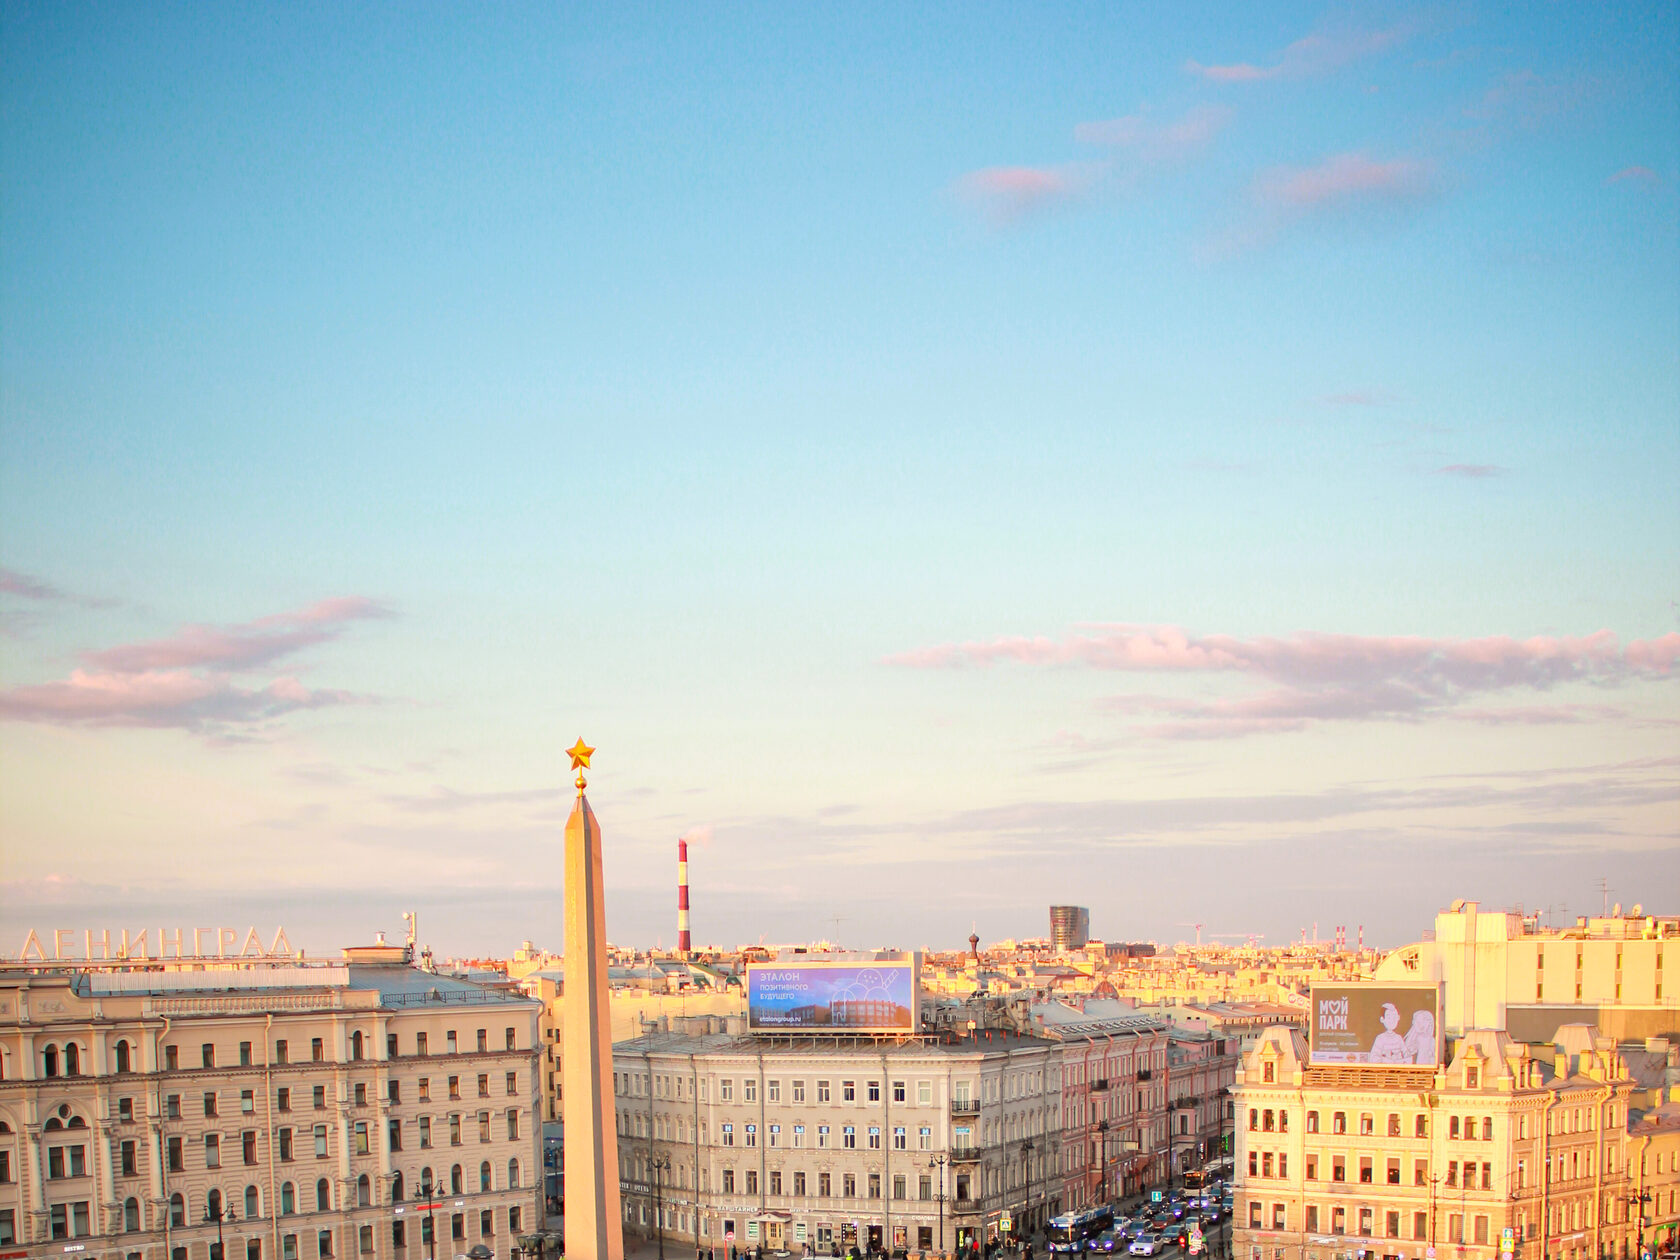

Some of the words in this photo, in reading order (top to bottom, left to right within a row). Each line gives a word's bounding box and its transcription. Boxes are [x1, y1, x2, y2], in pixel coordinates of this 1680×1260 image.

[20, 926, 297, 960] ЛЕНИНГРАД
[760, 972, 800, 981] ЭТАЛОН
[1319, 1015, 1348, 1030] ПАРК
